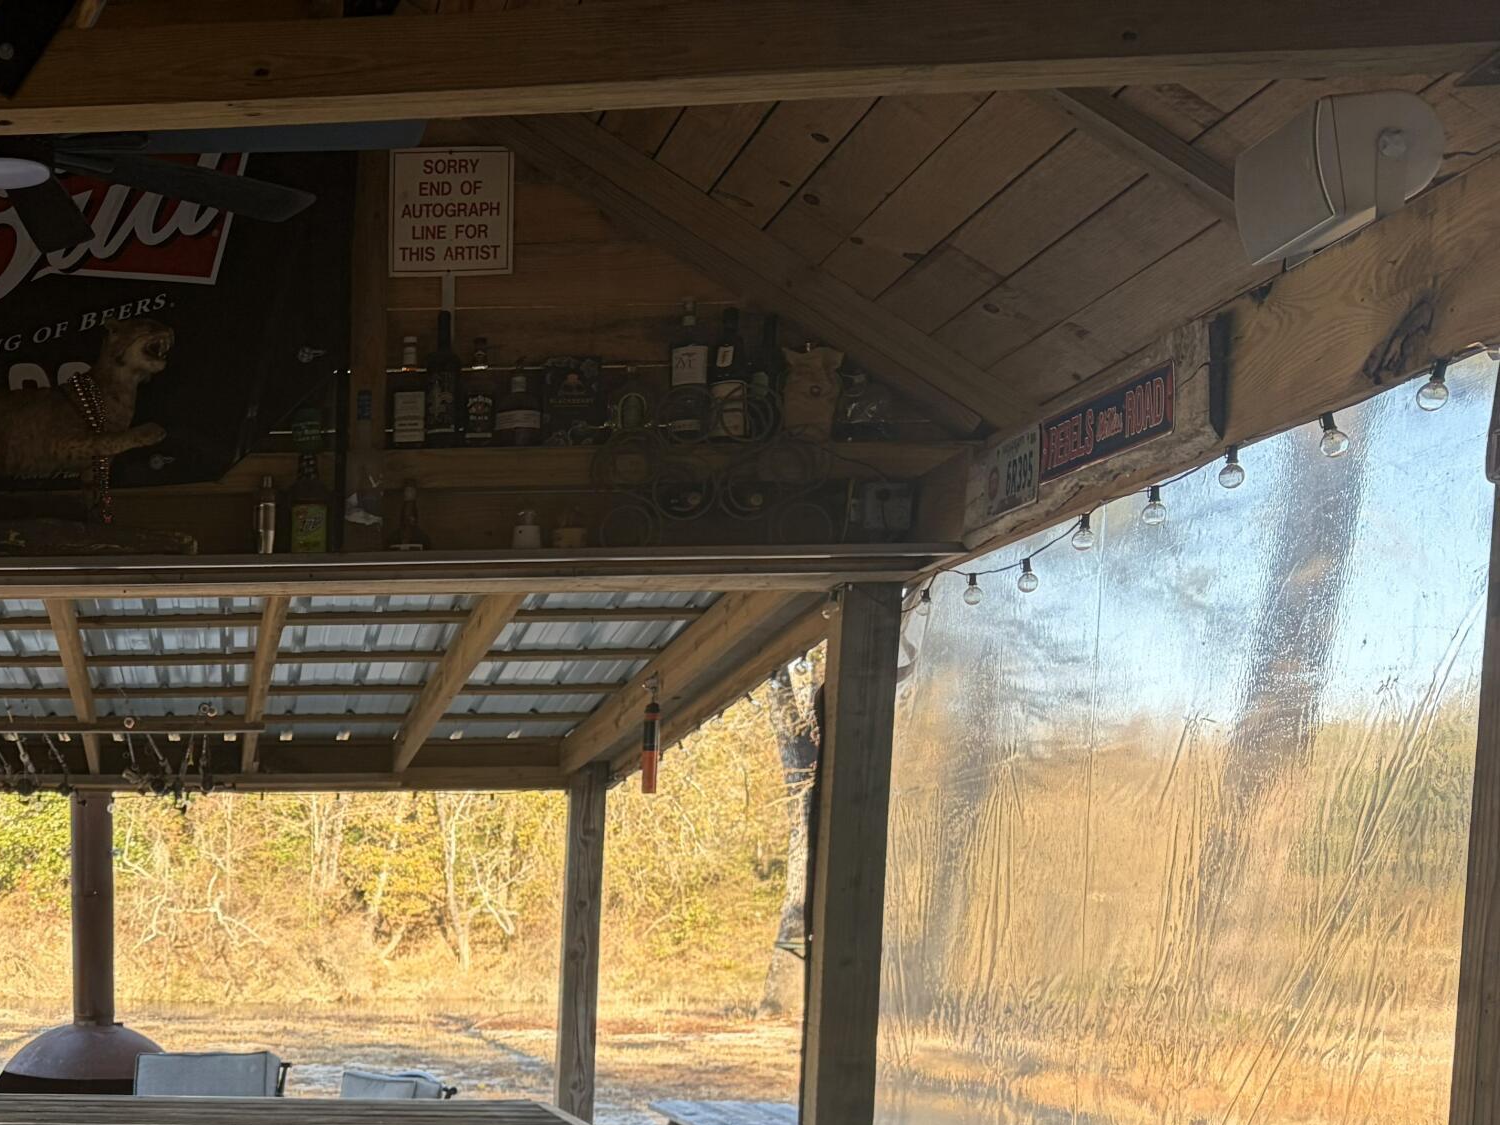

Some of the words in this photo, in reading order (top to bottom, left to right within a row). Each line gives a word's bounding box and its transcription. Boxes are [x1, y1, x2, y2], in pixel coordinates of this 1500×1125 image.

[423, 159, 479, 174] SORRY
[419, 181, 452, 196] END
[460, 180, 482, 195] OF
[401, 202, 500, 218] AUTOGRAPH
[412, 225, 446, 240] LINE
[455, 224, 488, 239] FOR
[399, 247, 435, 262] THIS
[443, 245, 500, 261] ARTIST
[32, 321, 69, 345] OF
[1125, 377, 1164, 438] ROAD
[1048, 408, 1095, 470] REBELS
